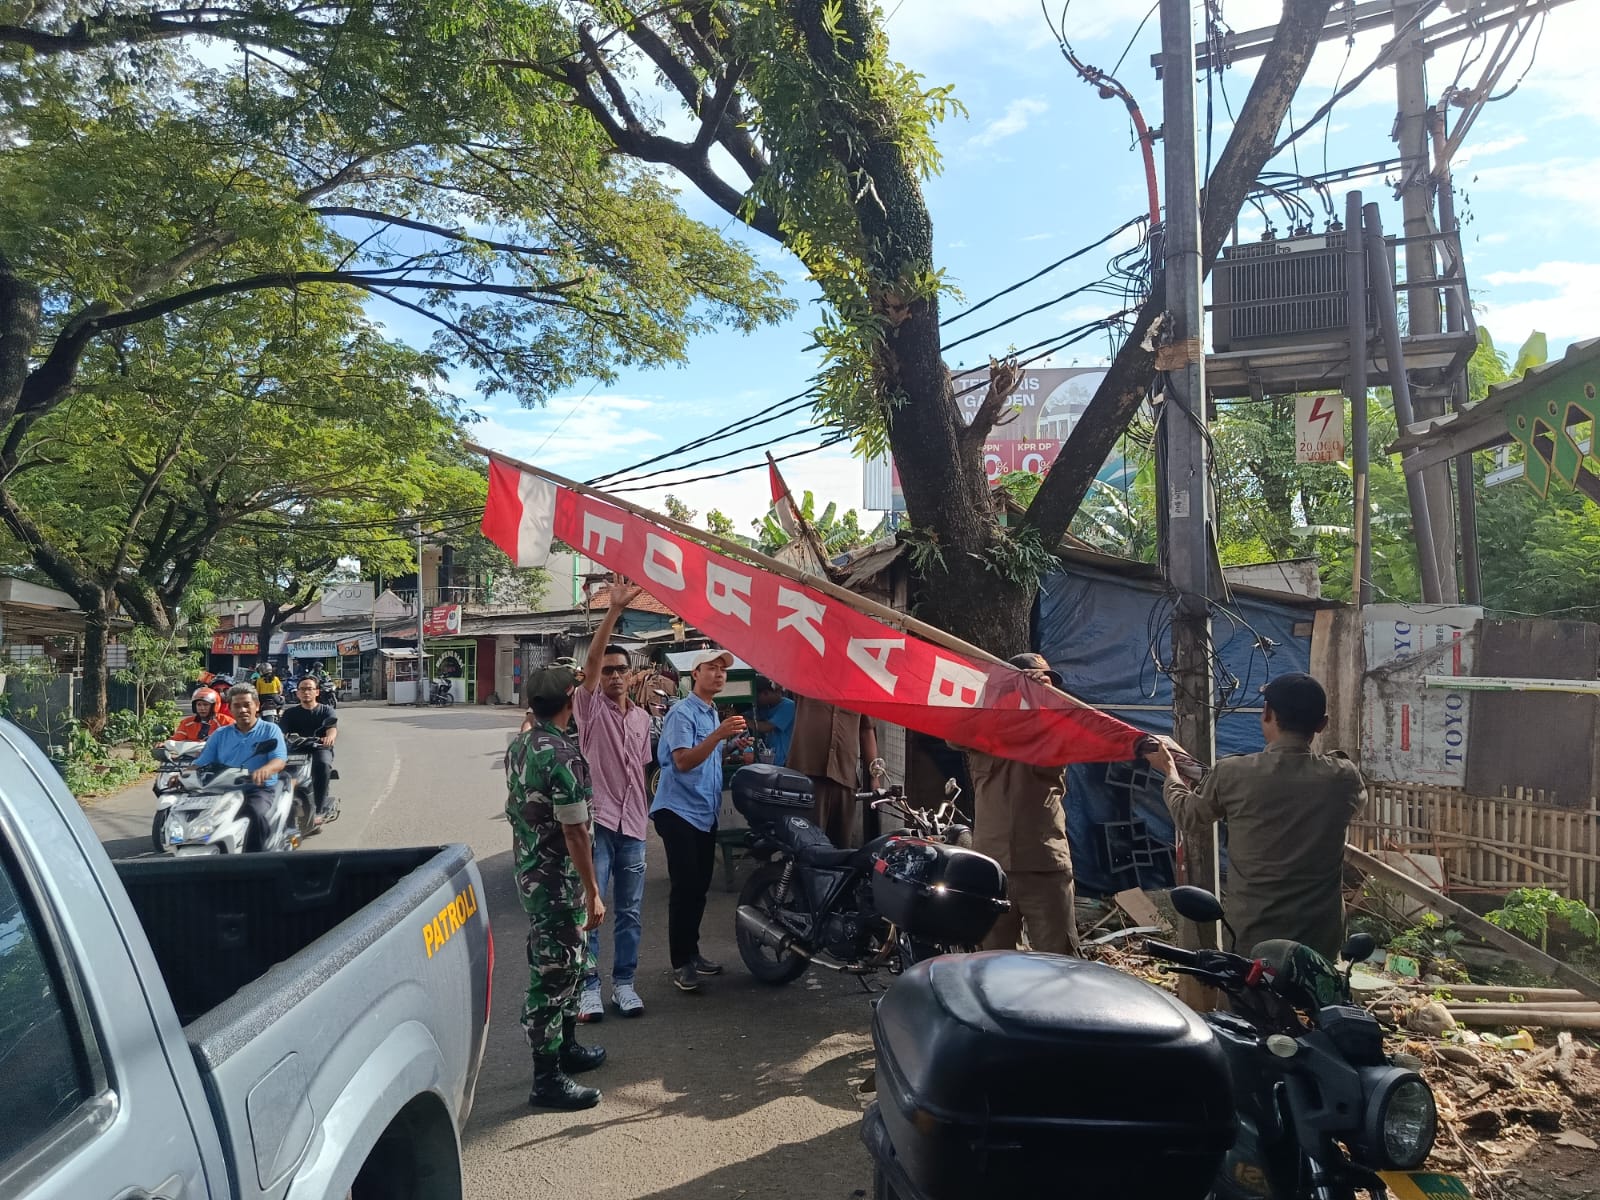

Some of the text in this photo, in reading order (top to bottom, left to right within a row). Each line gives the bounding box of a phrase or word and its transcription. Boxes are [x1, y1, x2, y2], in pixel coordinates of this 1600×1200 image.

[965, 394, 1034, 406] GADEN
[1017, 443, 1036, 451] KPR
[1445, 693, 1463, 766] TOYO
[422, 883, 478, 960] PATROLI
